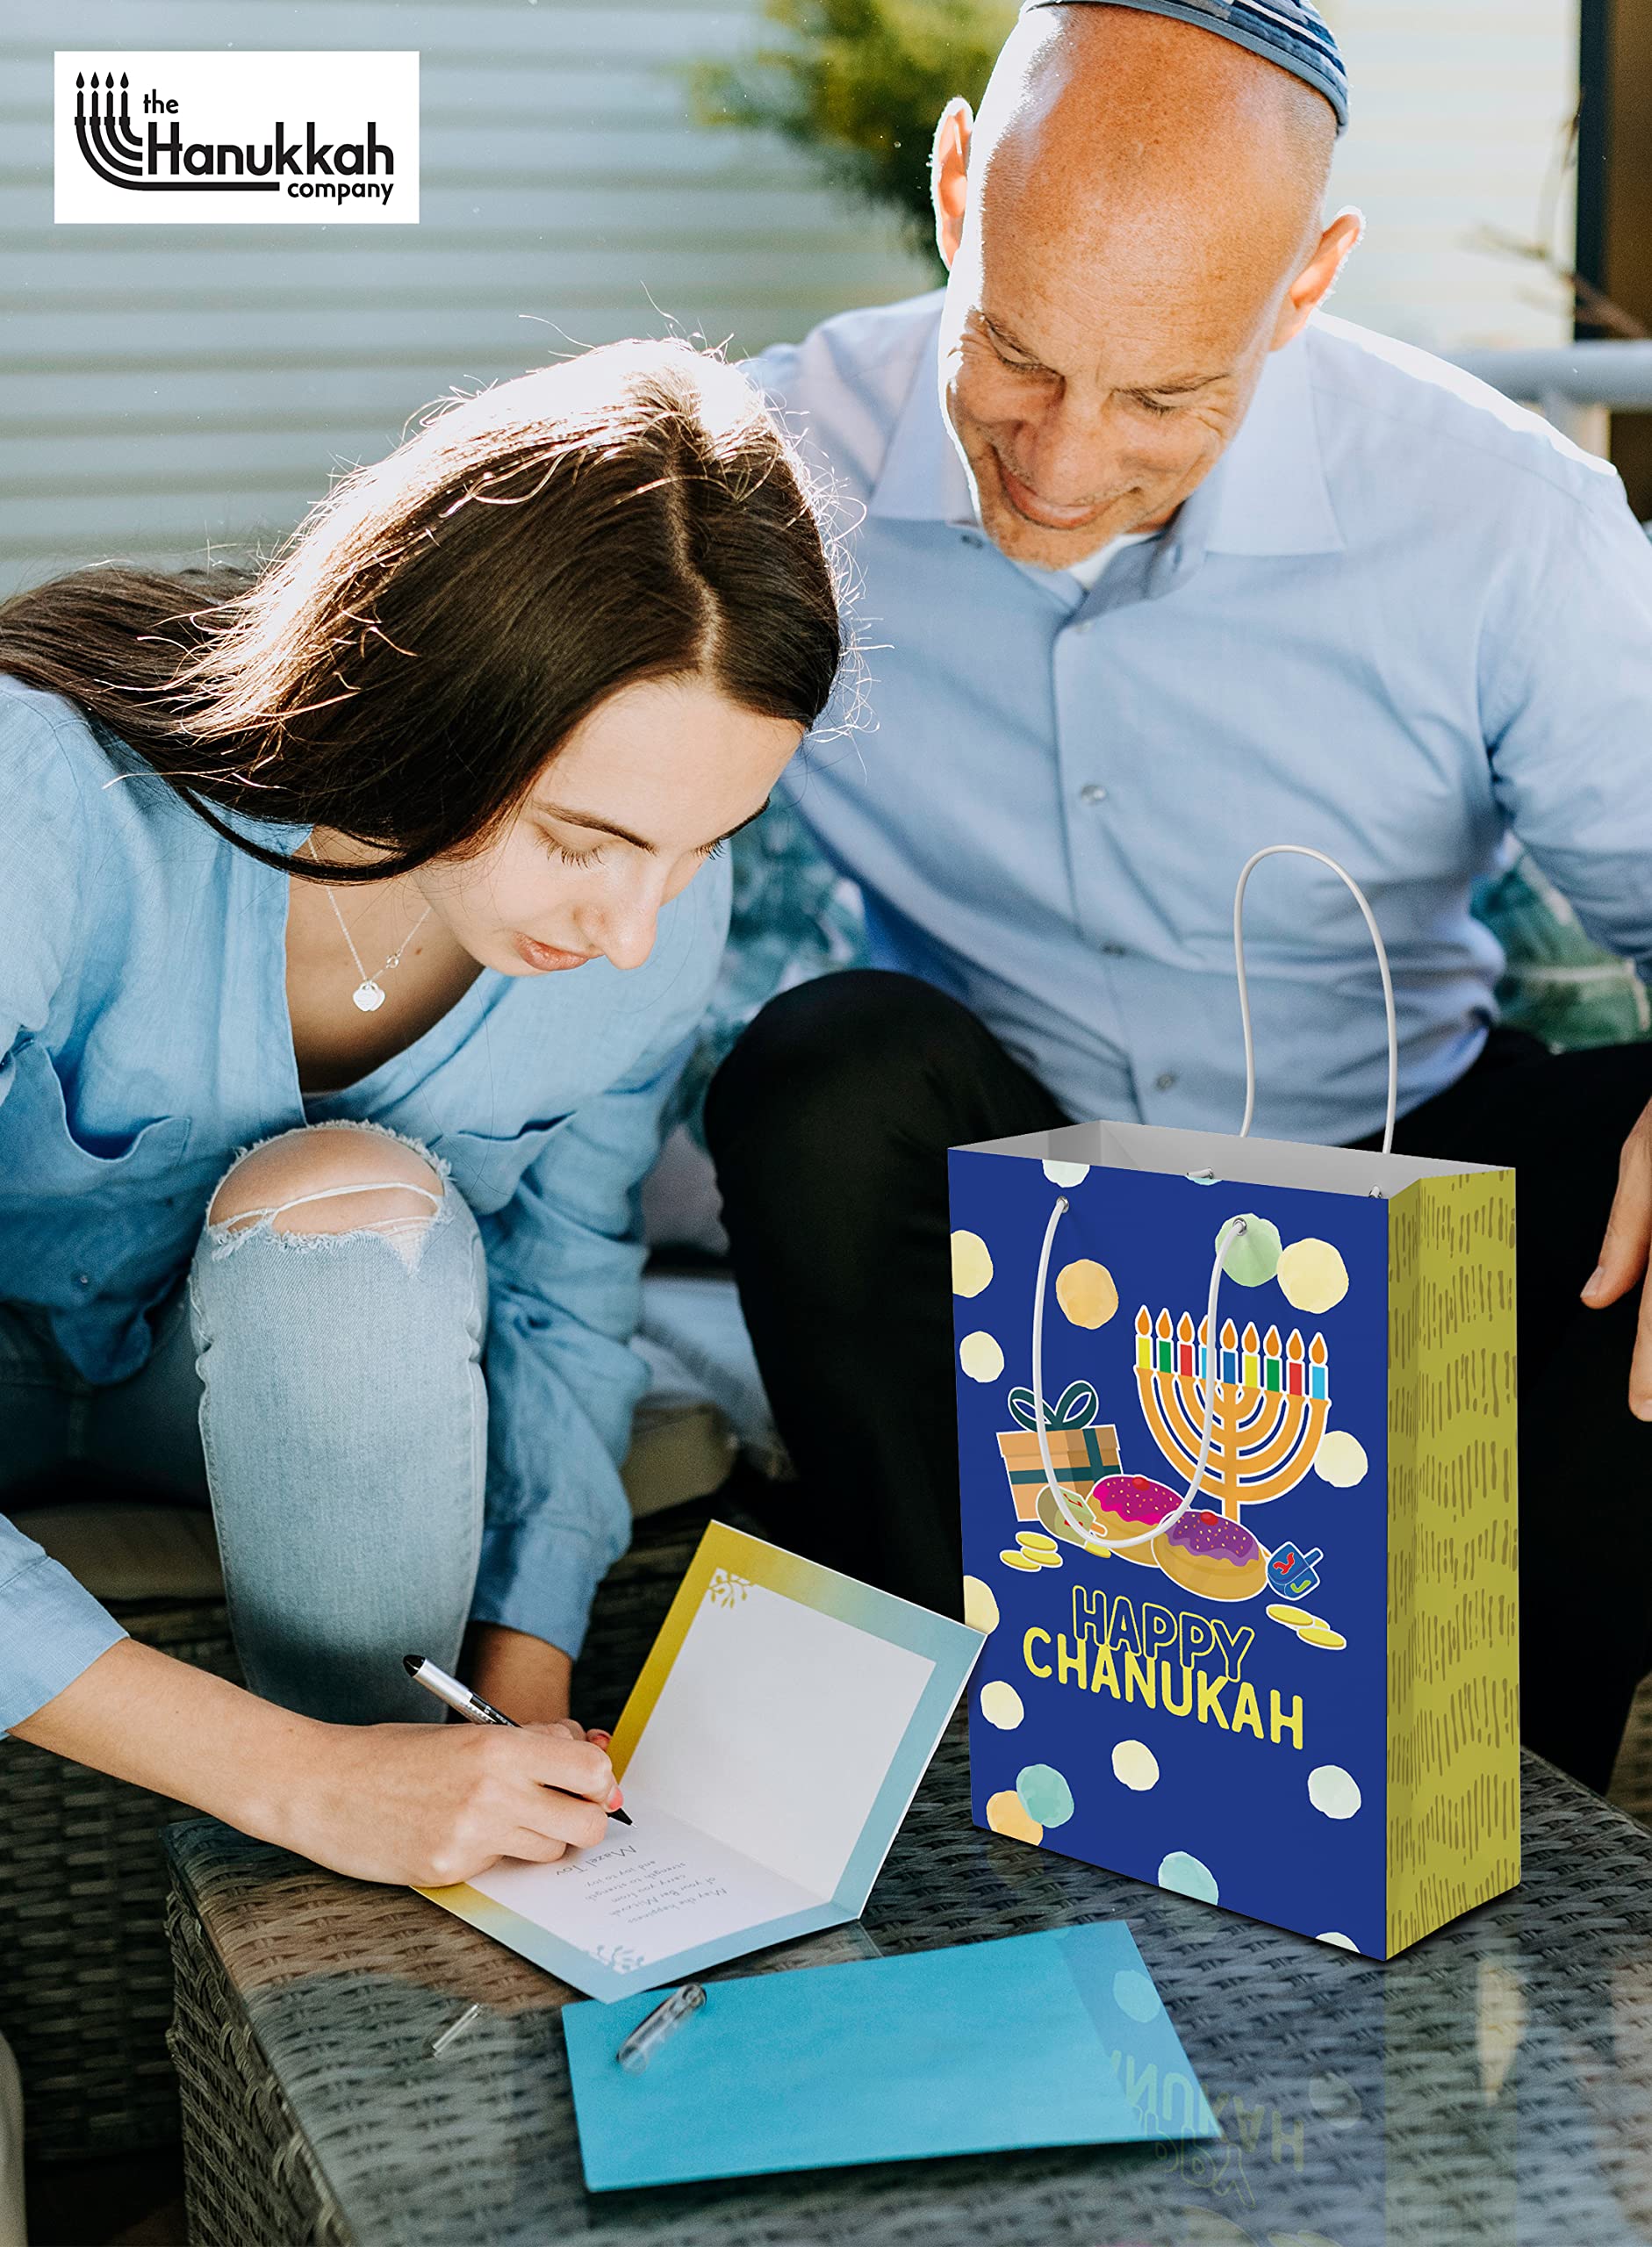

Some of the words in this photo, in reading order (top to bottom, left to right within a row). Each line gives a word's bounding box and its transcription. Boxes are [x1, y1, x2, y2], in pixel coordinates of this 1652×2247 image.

[1072, 1585, 1255, 1682] HAPPY
[1023, 1626, 1304, 1750] CHANUKAH
[556, 1864, 589, 1876] Tov
[585, 1844, 637, 1868] Mazel
